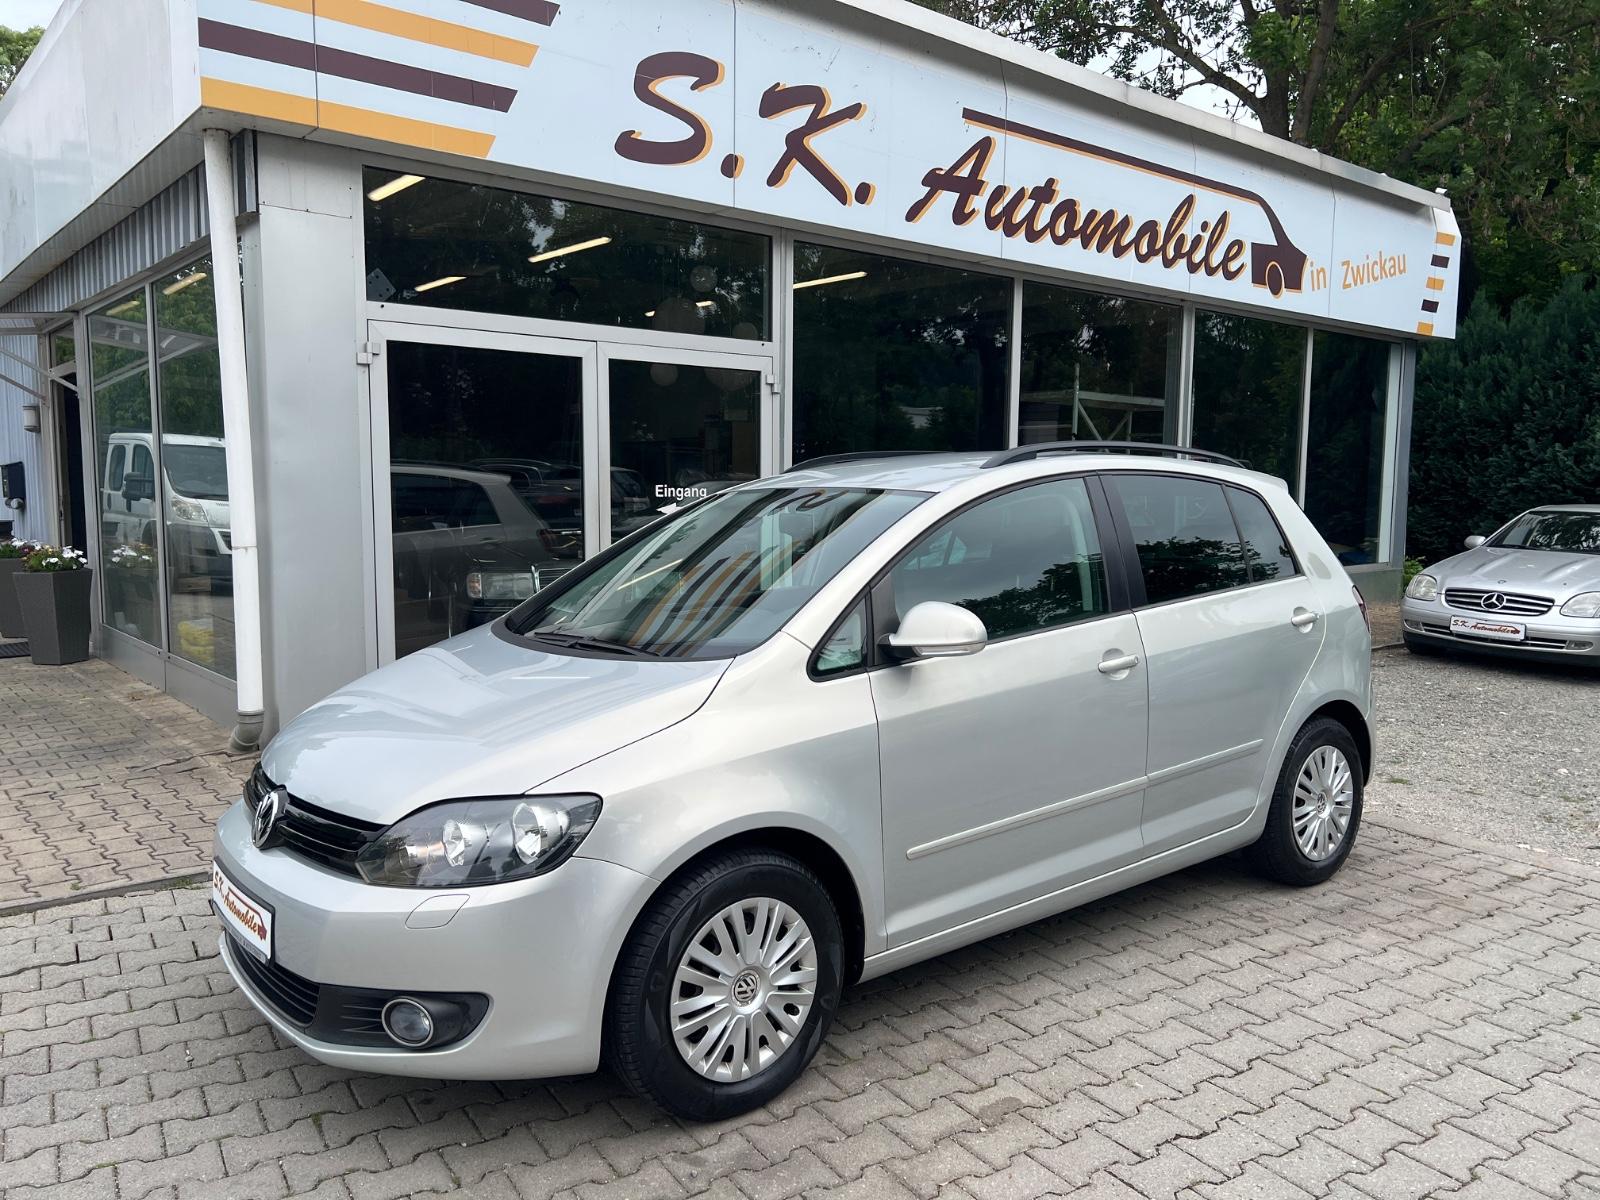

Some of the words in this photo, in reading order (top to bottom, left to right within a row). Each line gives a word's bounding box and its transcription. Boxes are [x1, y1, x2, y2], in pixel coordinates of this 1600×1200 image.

[614, 51, 877, 207] S.K.
[905, 136, 1248, 281] Automobile
[1309, 260, 1327, 291] in
[1341, 250, 1407, 289] Zwickau
[655, 484, 707, 500] Eingang
